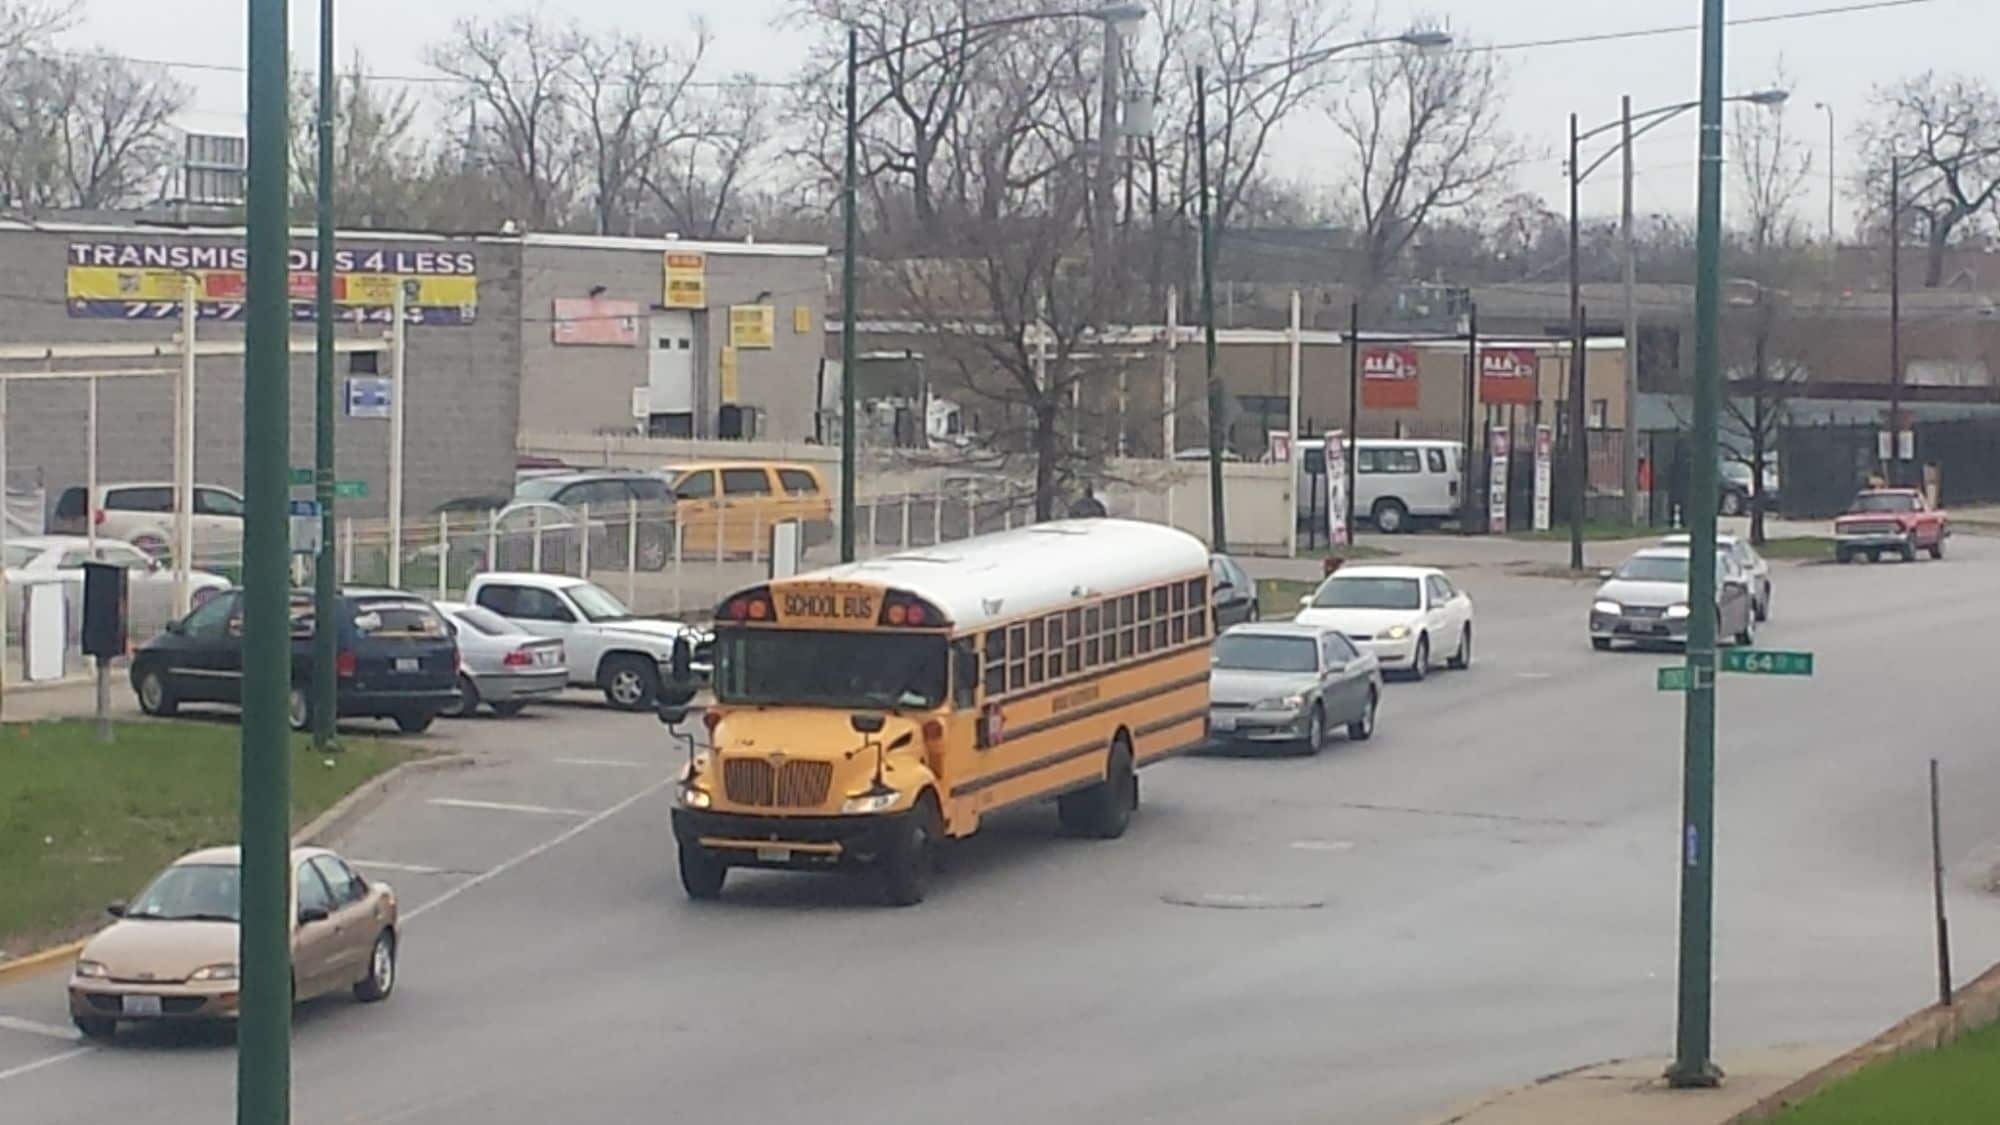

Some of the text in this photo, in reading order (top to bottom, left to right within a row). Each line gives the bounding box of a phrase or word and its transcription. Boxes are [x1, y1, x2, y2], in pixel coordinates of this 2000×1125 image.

[364, 251, 385, 272] 4
[397, 252, 475, 273] LESS
[783, 593, 873, 619] SCHOOL BUS
